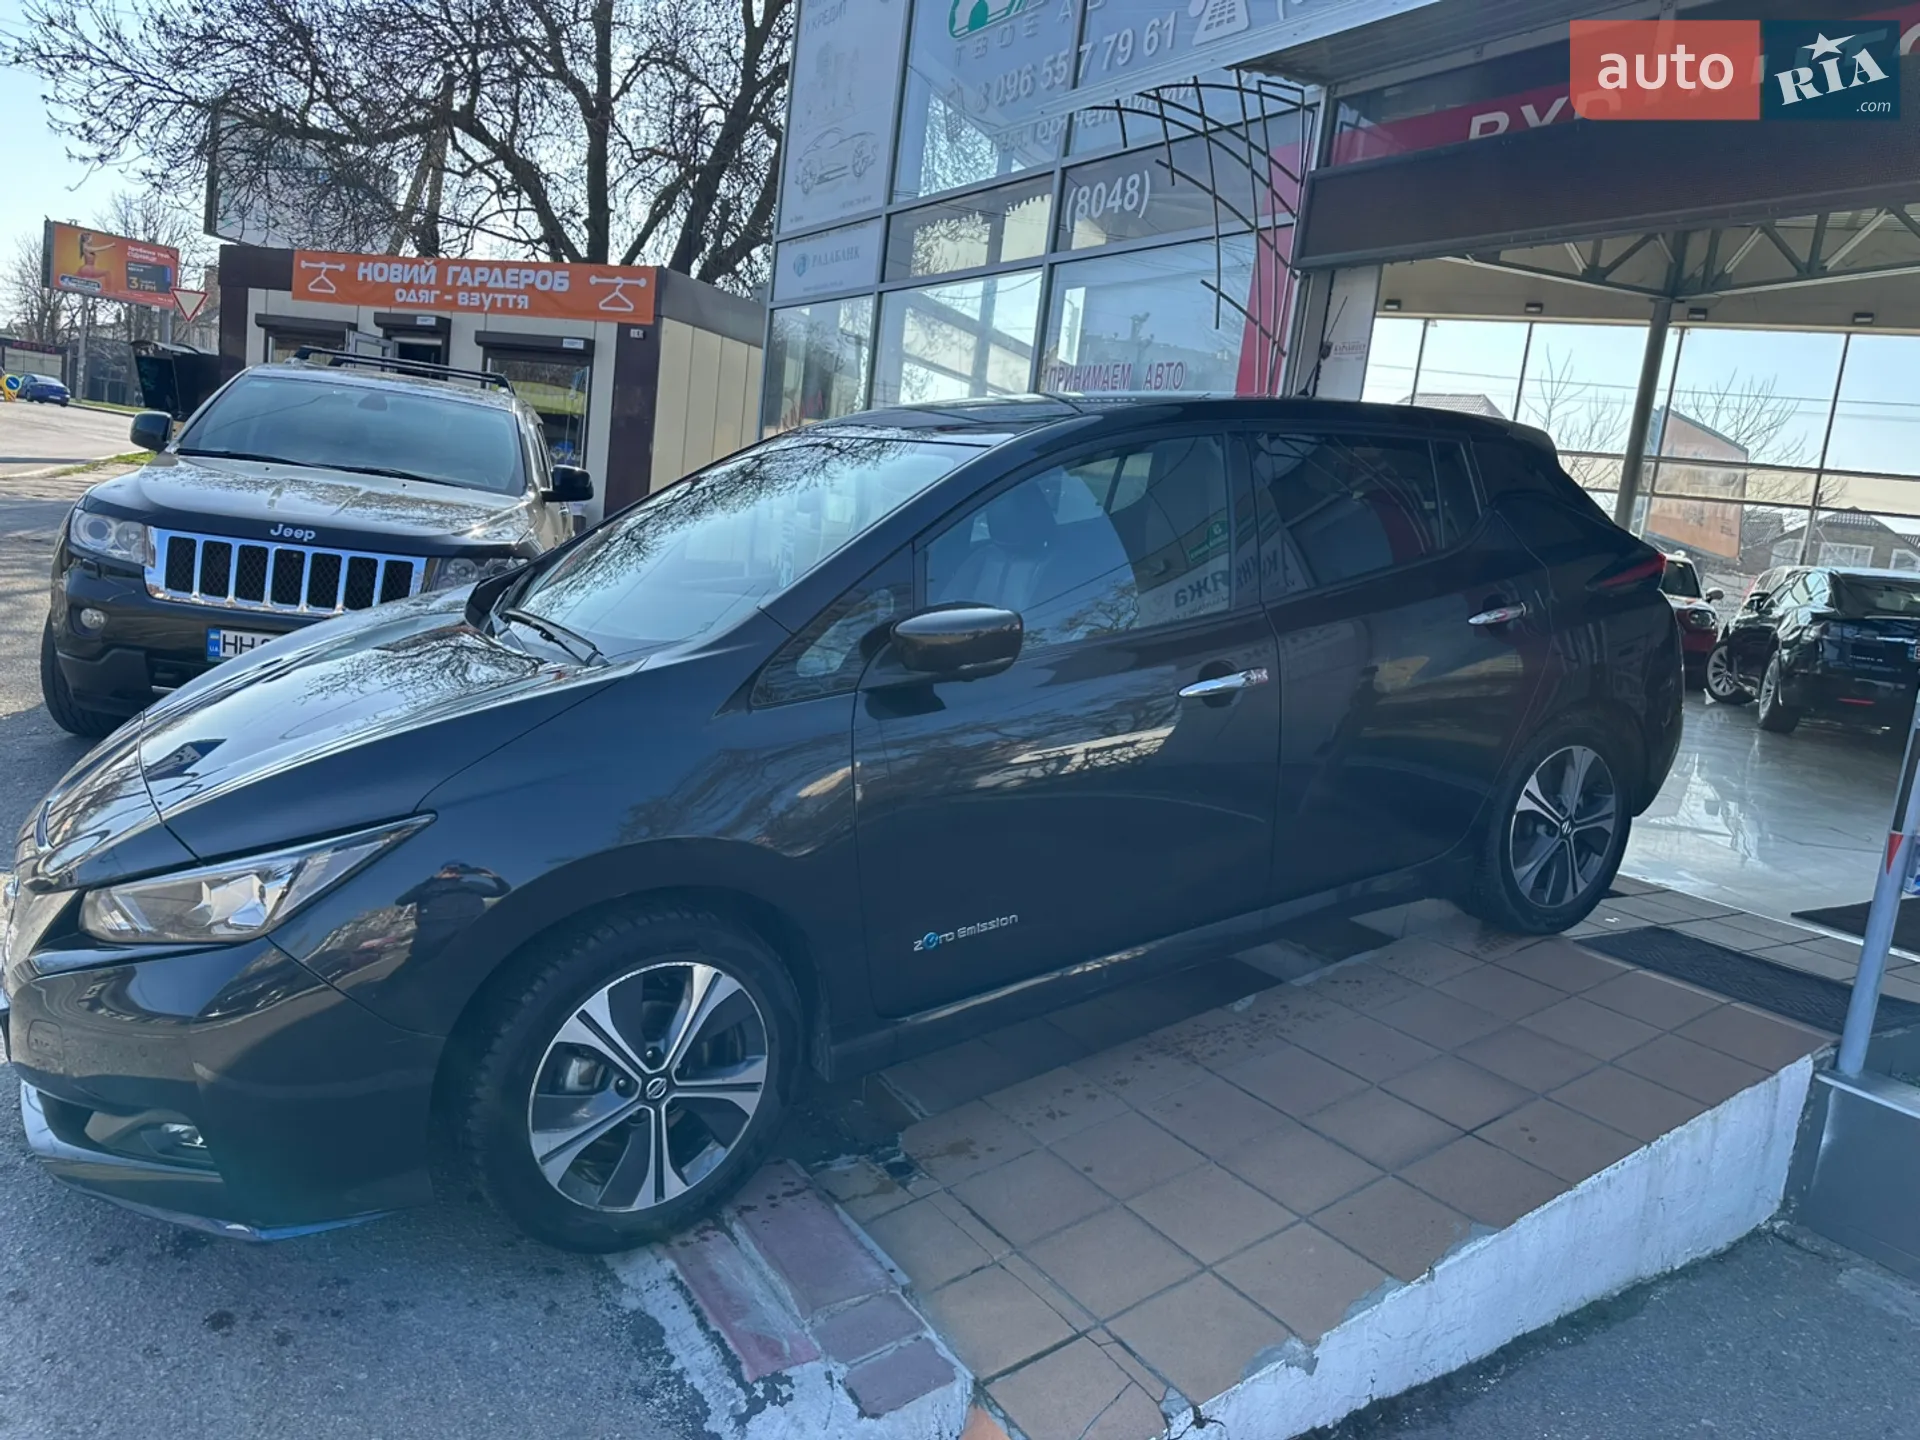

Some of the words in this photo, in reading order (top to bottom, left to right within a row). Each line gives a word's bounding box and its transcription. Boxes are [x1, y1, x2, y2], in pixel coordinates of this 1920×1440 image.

[995, 63, 1036, 106] 096
[1101, 28, 1135, 71] 79
[1142, 10, 1179, 57] 61
[1066, 169, 1151, 233] (8048)
[357, 260, 438, 285] НОВИЙ
[446, 265, 570, 292] ГАРДЕРОБ
[395, 288, 441, 304] ОДЯГ
[1047, 363, 1132, 392] ПРИНИМАЕМ
[1143, 360, 1186, 391] АВТО
[270, 523, 316, 542] Jeep
[913, 931, 955, 952] zero
[957, 914, 1019, 938] Emission
